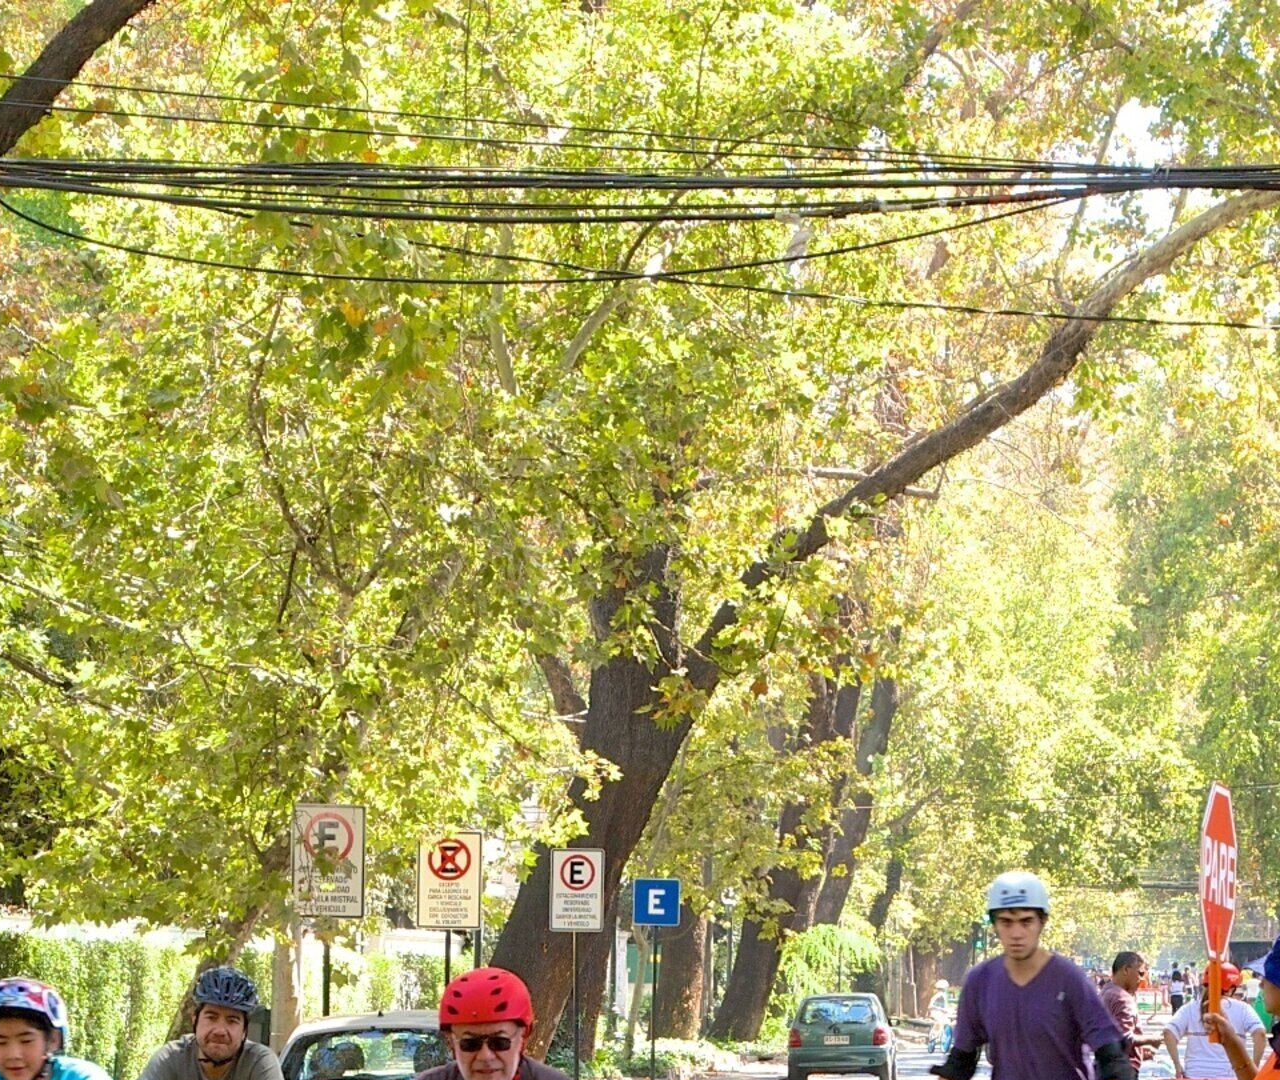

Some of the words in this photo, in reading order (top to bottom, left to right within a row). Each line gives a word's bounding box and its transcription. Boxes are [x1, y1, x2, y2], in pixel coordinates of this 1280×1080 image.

[570, 861, 584, 884] E
[1204, 836, 1236, 911] PARE
[648, 889, 666, 915] E
